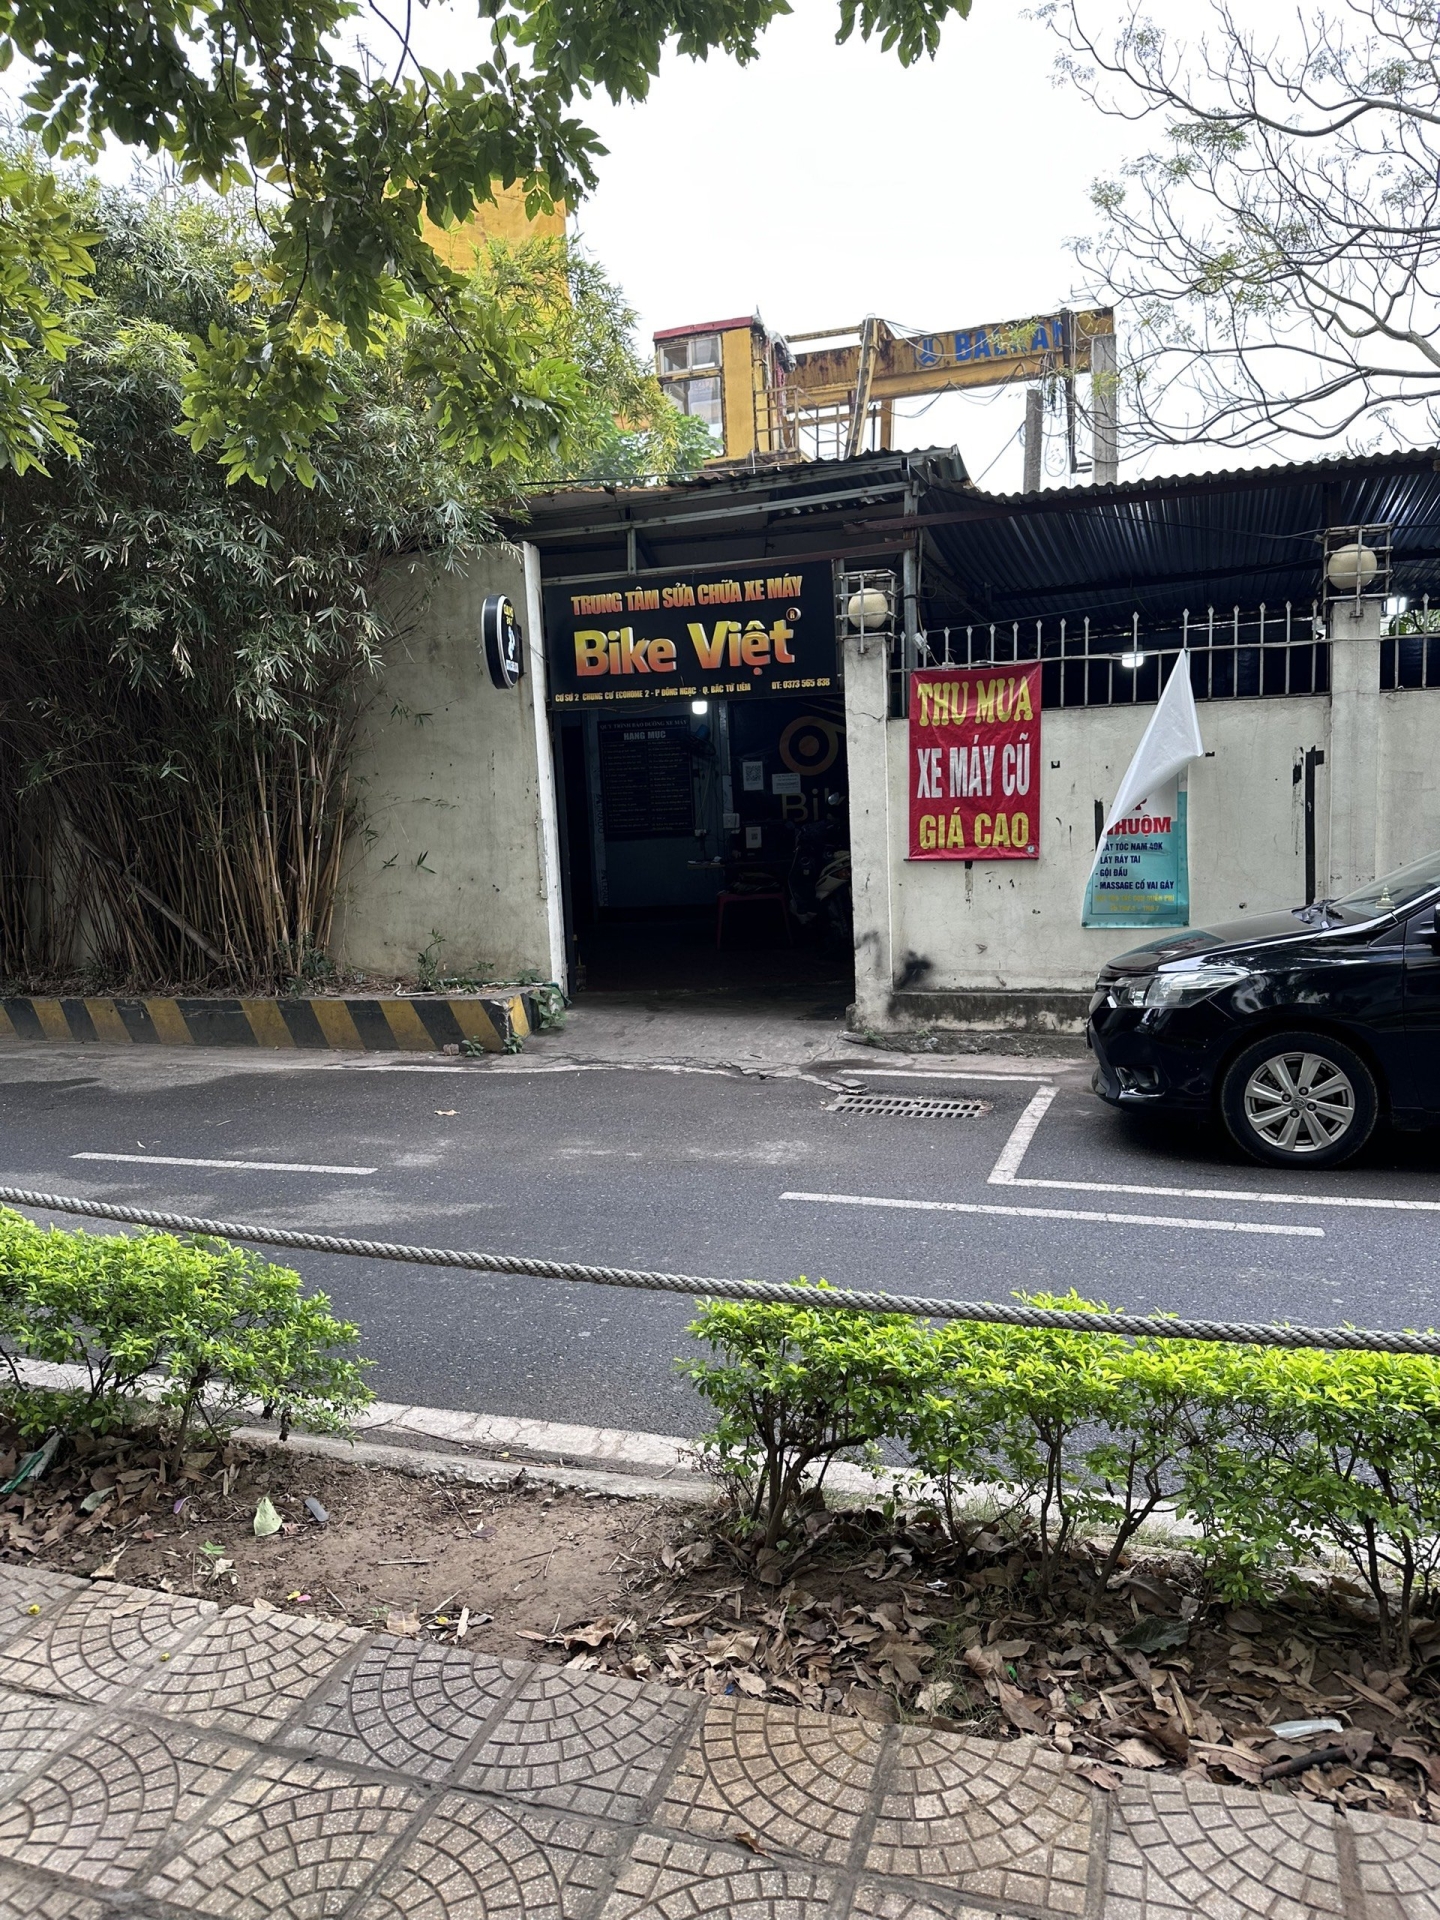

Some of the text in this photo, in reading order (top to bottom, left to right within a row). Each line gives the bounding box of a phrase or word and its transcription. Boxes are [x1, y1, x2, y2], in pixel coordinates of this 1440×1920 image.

[955, 319, 1063, 361] BALAN
[570, 573, 803, 615] TRUNG TÂM SỬA CHỮA XE MÁY
[573, 627, 677, 676] Bike
[687, 619, 795, 676] Việt
[574, 693, 580, 702] 2
[582, 692, 604, 701] CHUNG
[644, 689, 650, 698] 2
[783, 679, 800, 689] 0373
[917, 676, 1033, 727] THU MUA
[623, 730, 666, 742] HẠNG MỤC
[917, 732, 1031, 798] XE MÁY CŨ
[919, 806, 1029, 850] GIÁ CAO
[1116, 842, 1129, 851] TÓC
[1131, 842, 1148, 850] NAM
[1130, 855, 1141, 863] TAI
[1100, 881, 1134, 890] MASSAGE
[1147, 881, 1158, 890] VAI
[1159, 879, 1175, 890] GÁY
